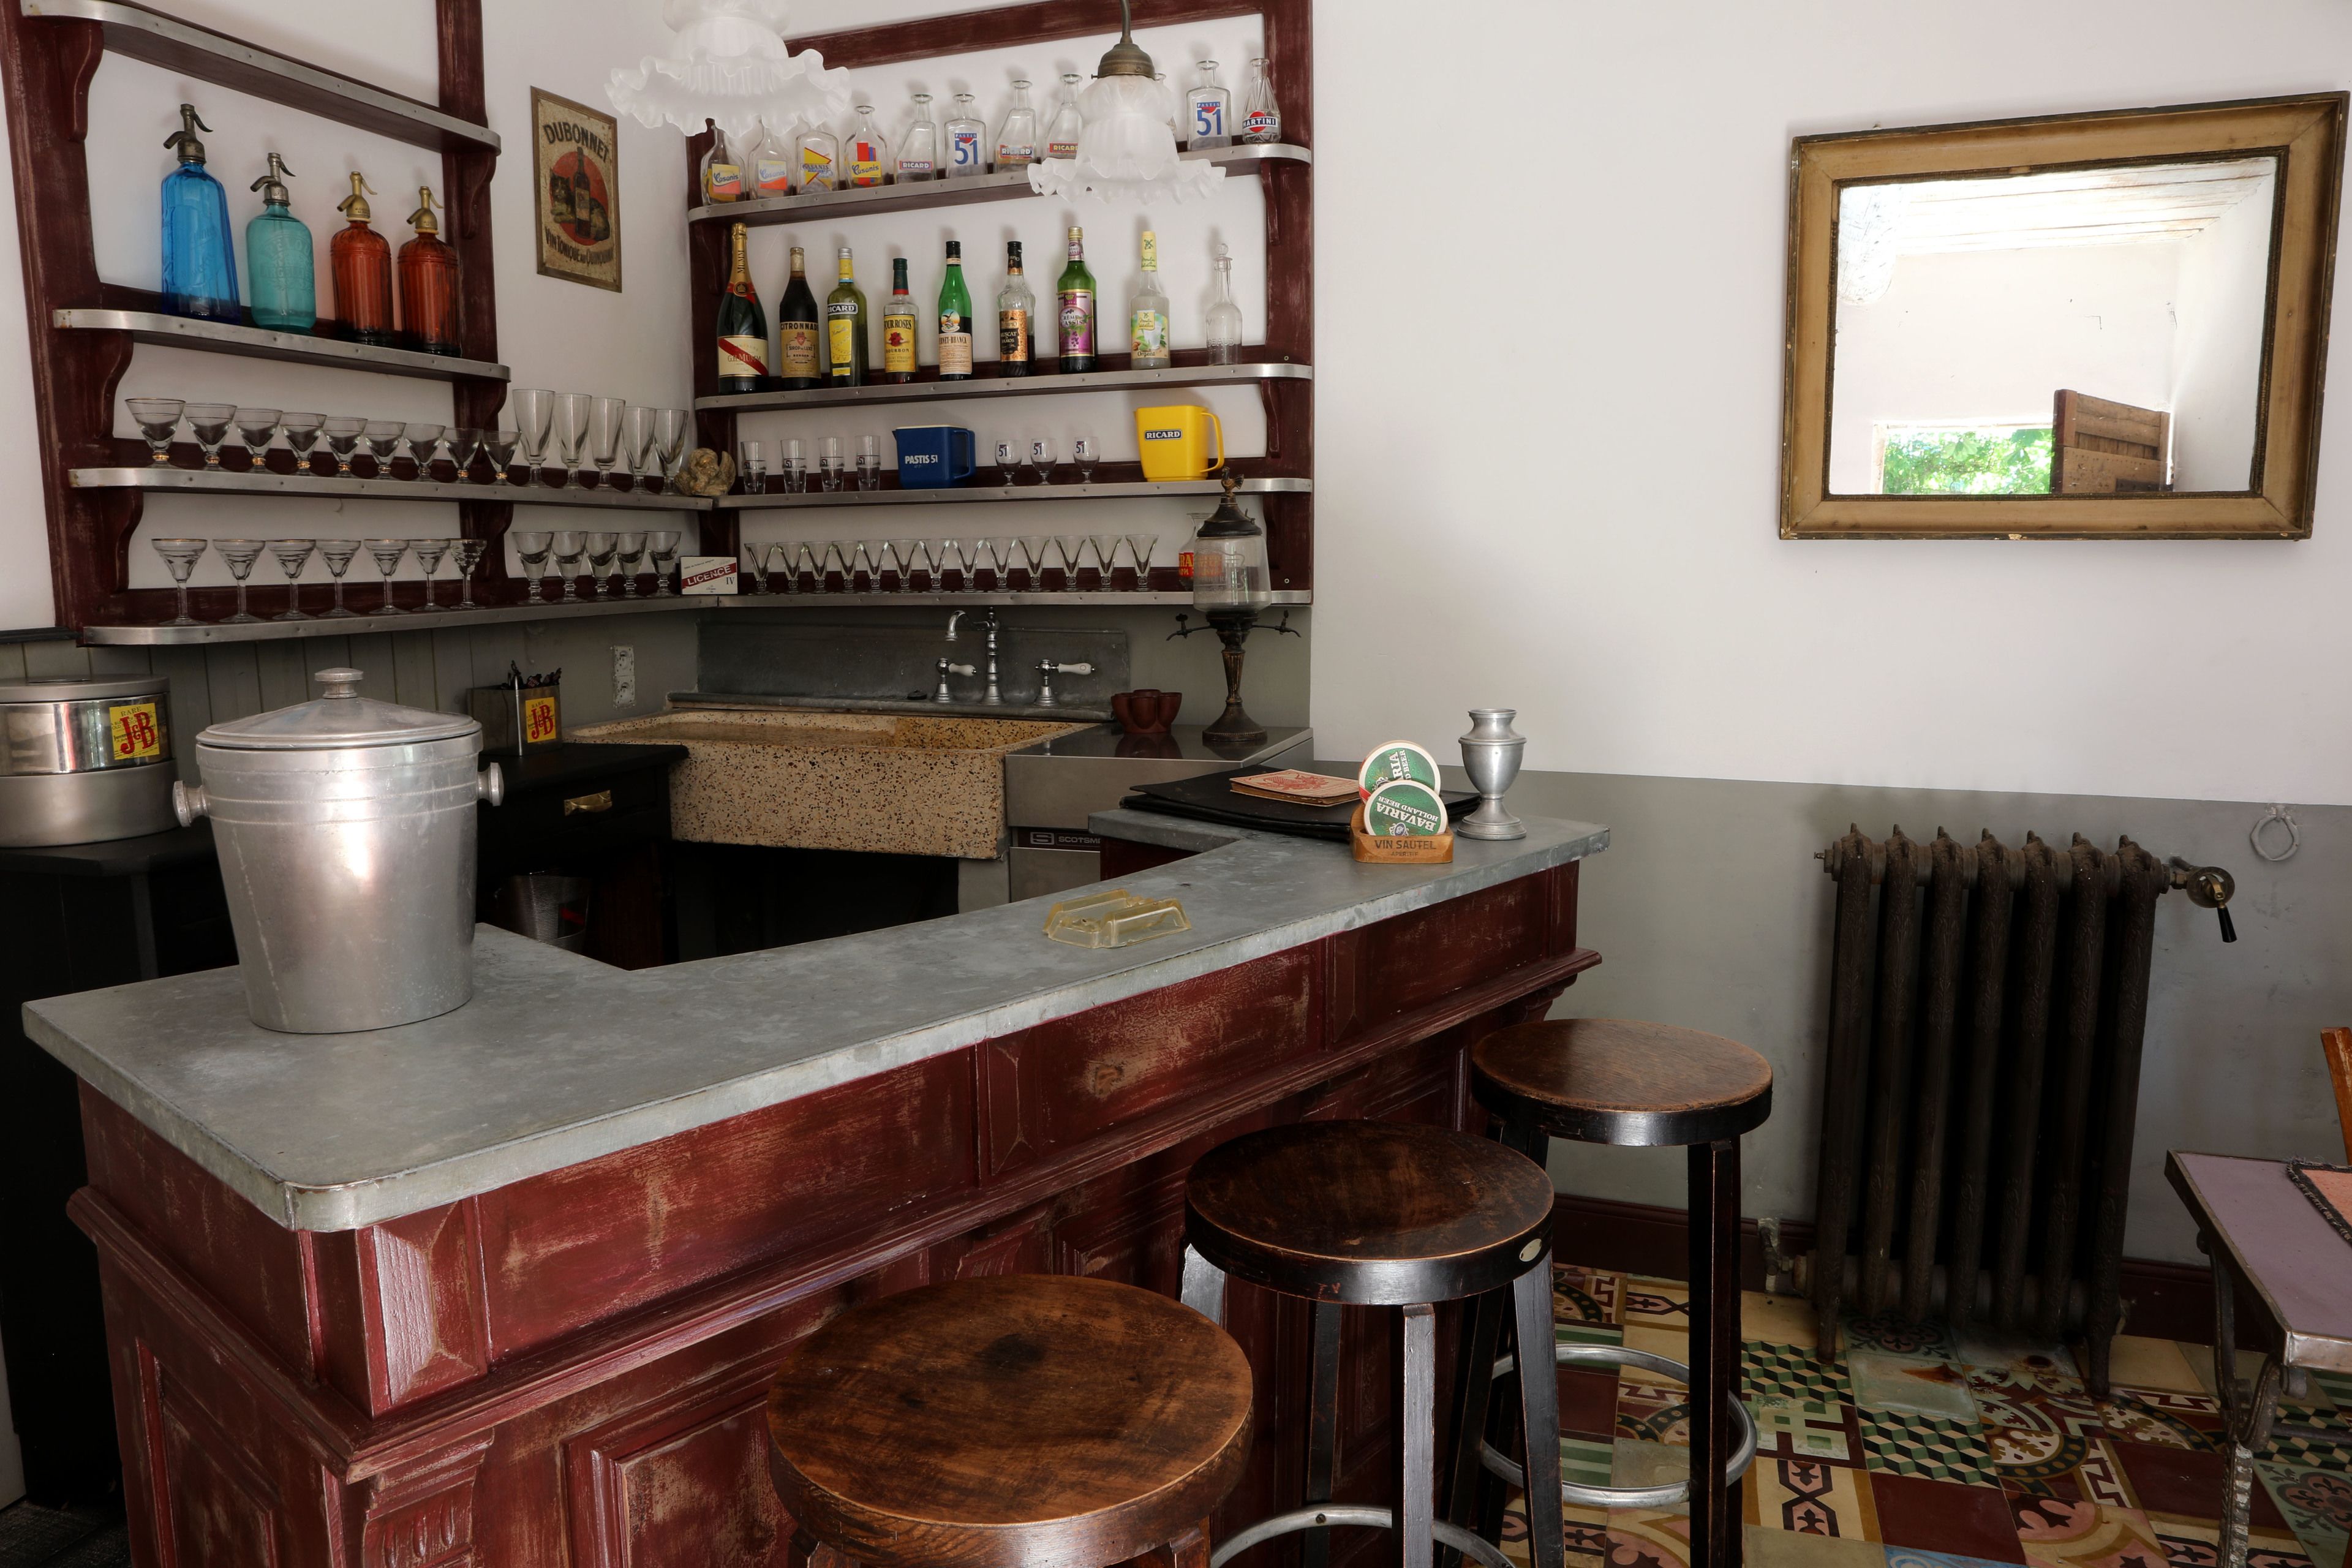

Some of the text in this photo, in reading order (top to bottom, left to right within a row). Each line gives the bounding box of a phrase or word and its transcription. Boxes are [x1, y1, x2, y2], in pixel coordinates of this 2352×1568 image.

[1197, 108, 1221, 136] 51
[1243, 118, 1275, 128] MARTINI
[543, 121, 609, 163] DUBONNET
[954, 140, 978, 165] 51
[895, 319, 912, 330] ROSES
[998, 447, 1007, 457] 51
[1033, 445, 1042, 455] 51
[1076, 443, 1085, 453] 51
[905, 454, 938, 464] PASTIS 51
[687, 565, 732, 586] LICENCE
[120, 706, 142, 717] RARE
[531, 704, 554, 740] J&B
[119, 711, 156, 755] J&B
[1378, 795, 1439, 822] HOLLAND BEER
[1376, 802, 1436, 832] BAVARIA
[1374, 840, 1436, 850] VIN SAUTEL
